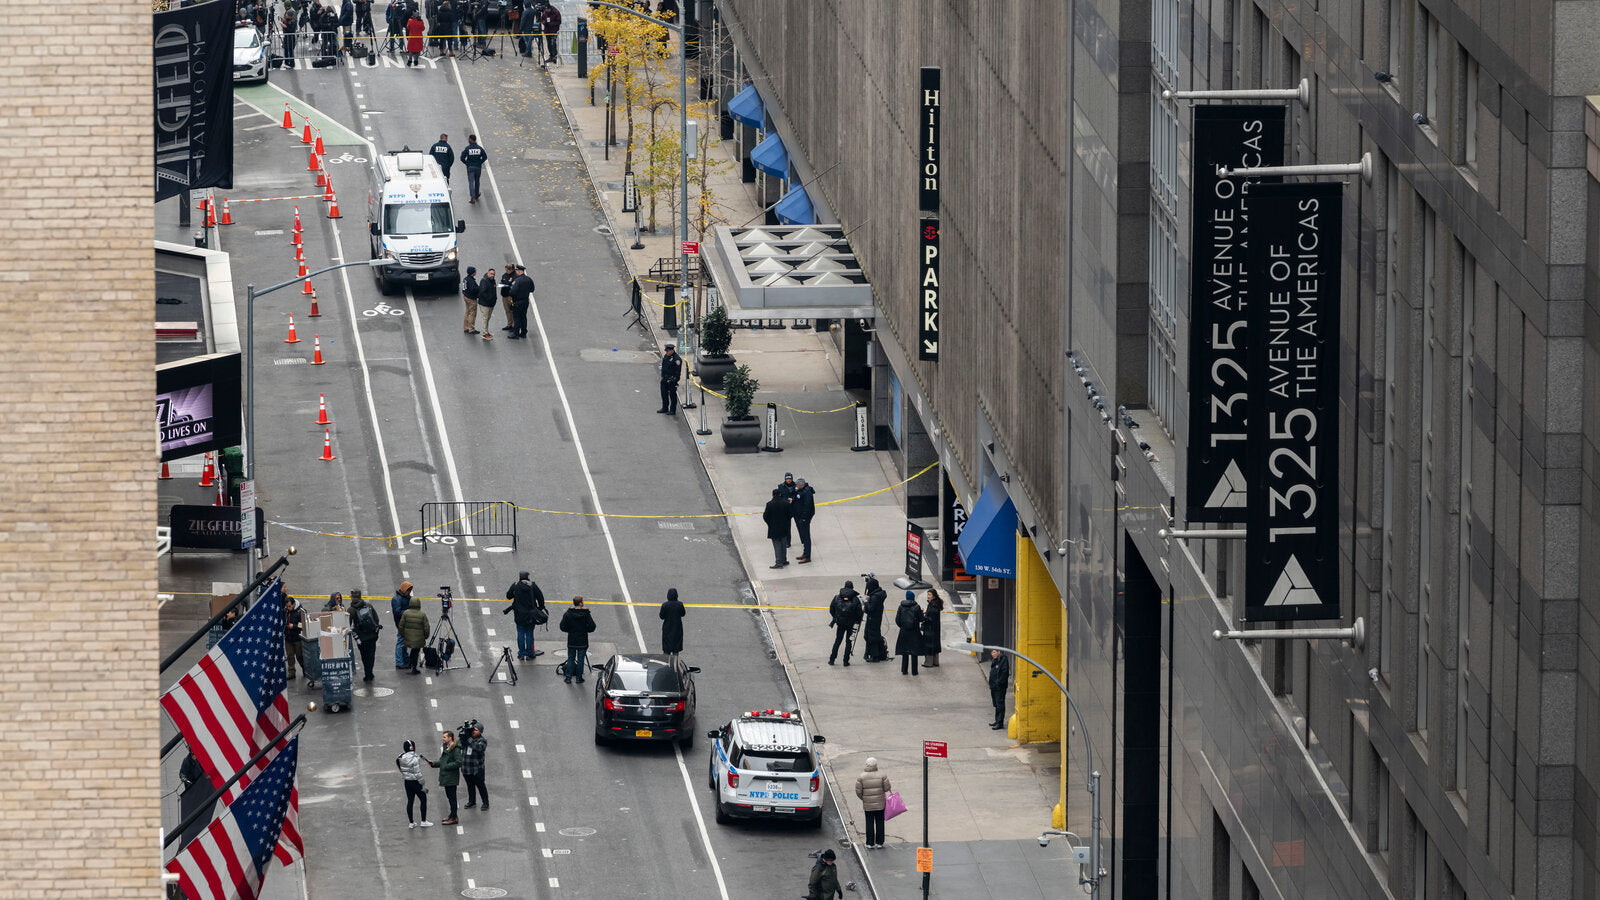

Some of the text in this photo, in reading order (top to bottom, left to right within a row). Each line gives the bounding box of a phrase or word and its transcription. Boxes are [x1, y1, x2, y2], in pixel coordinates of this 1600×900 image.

[924, 89, 940, 190] Hilton
[923, 245, 939, 332] PARK
[1213, 209, 1234, 311] AVENUE
[1296, 198, 1319, 398] THE AMERICAS
[1269, 245, 1290, 398] AVENUE OF
[169, 425, 190, 440] LIVES
[193, 421, 207, 434] ON
[1211, 320, 1248, 448] 1325
[1269, 408, 1317, 543] 1325
[749, 791, 769, 799] NYPD
[772, 792, 799, 800] POLICE
